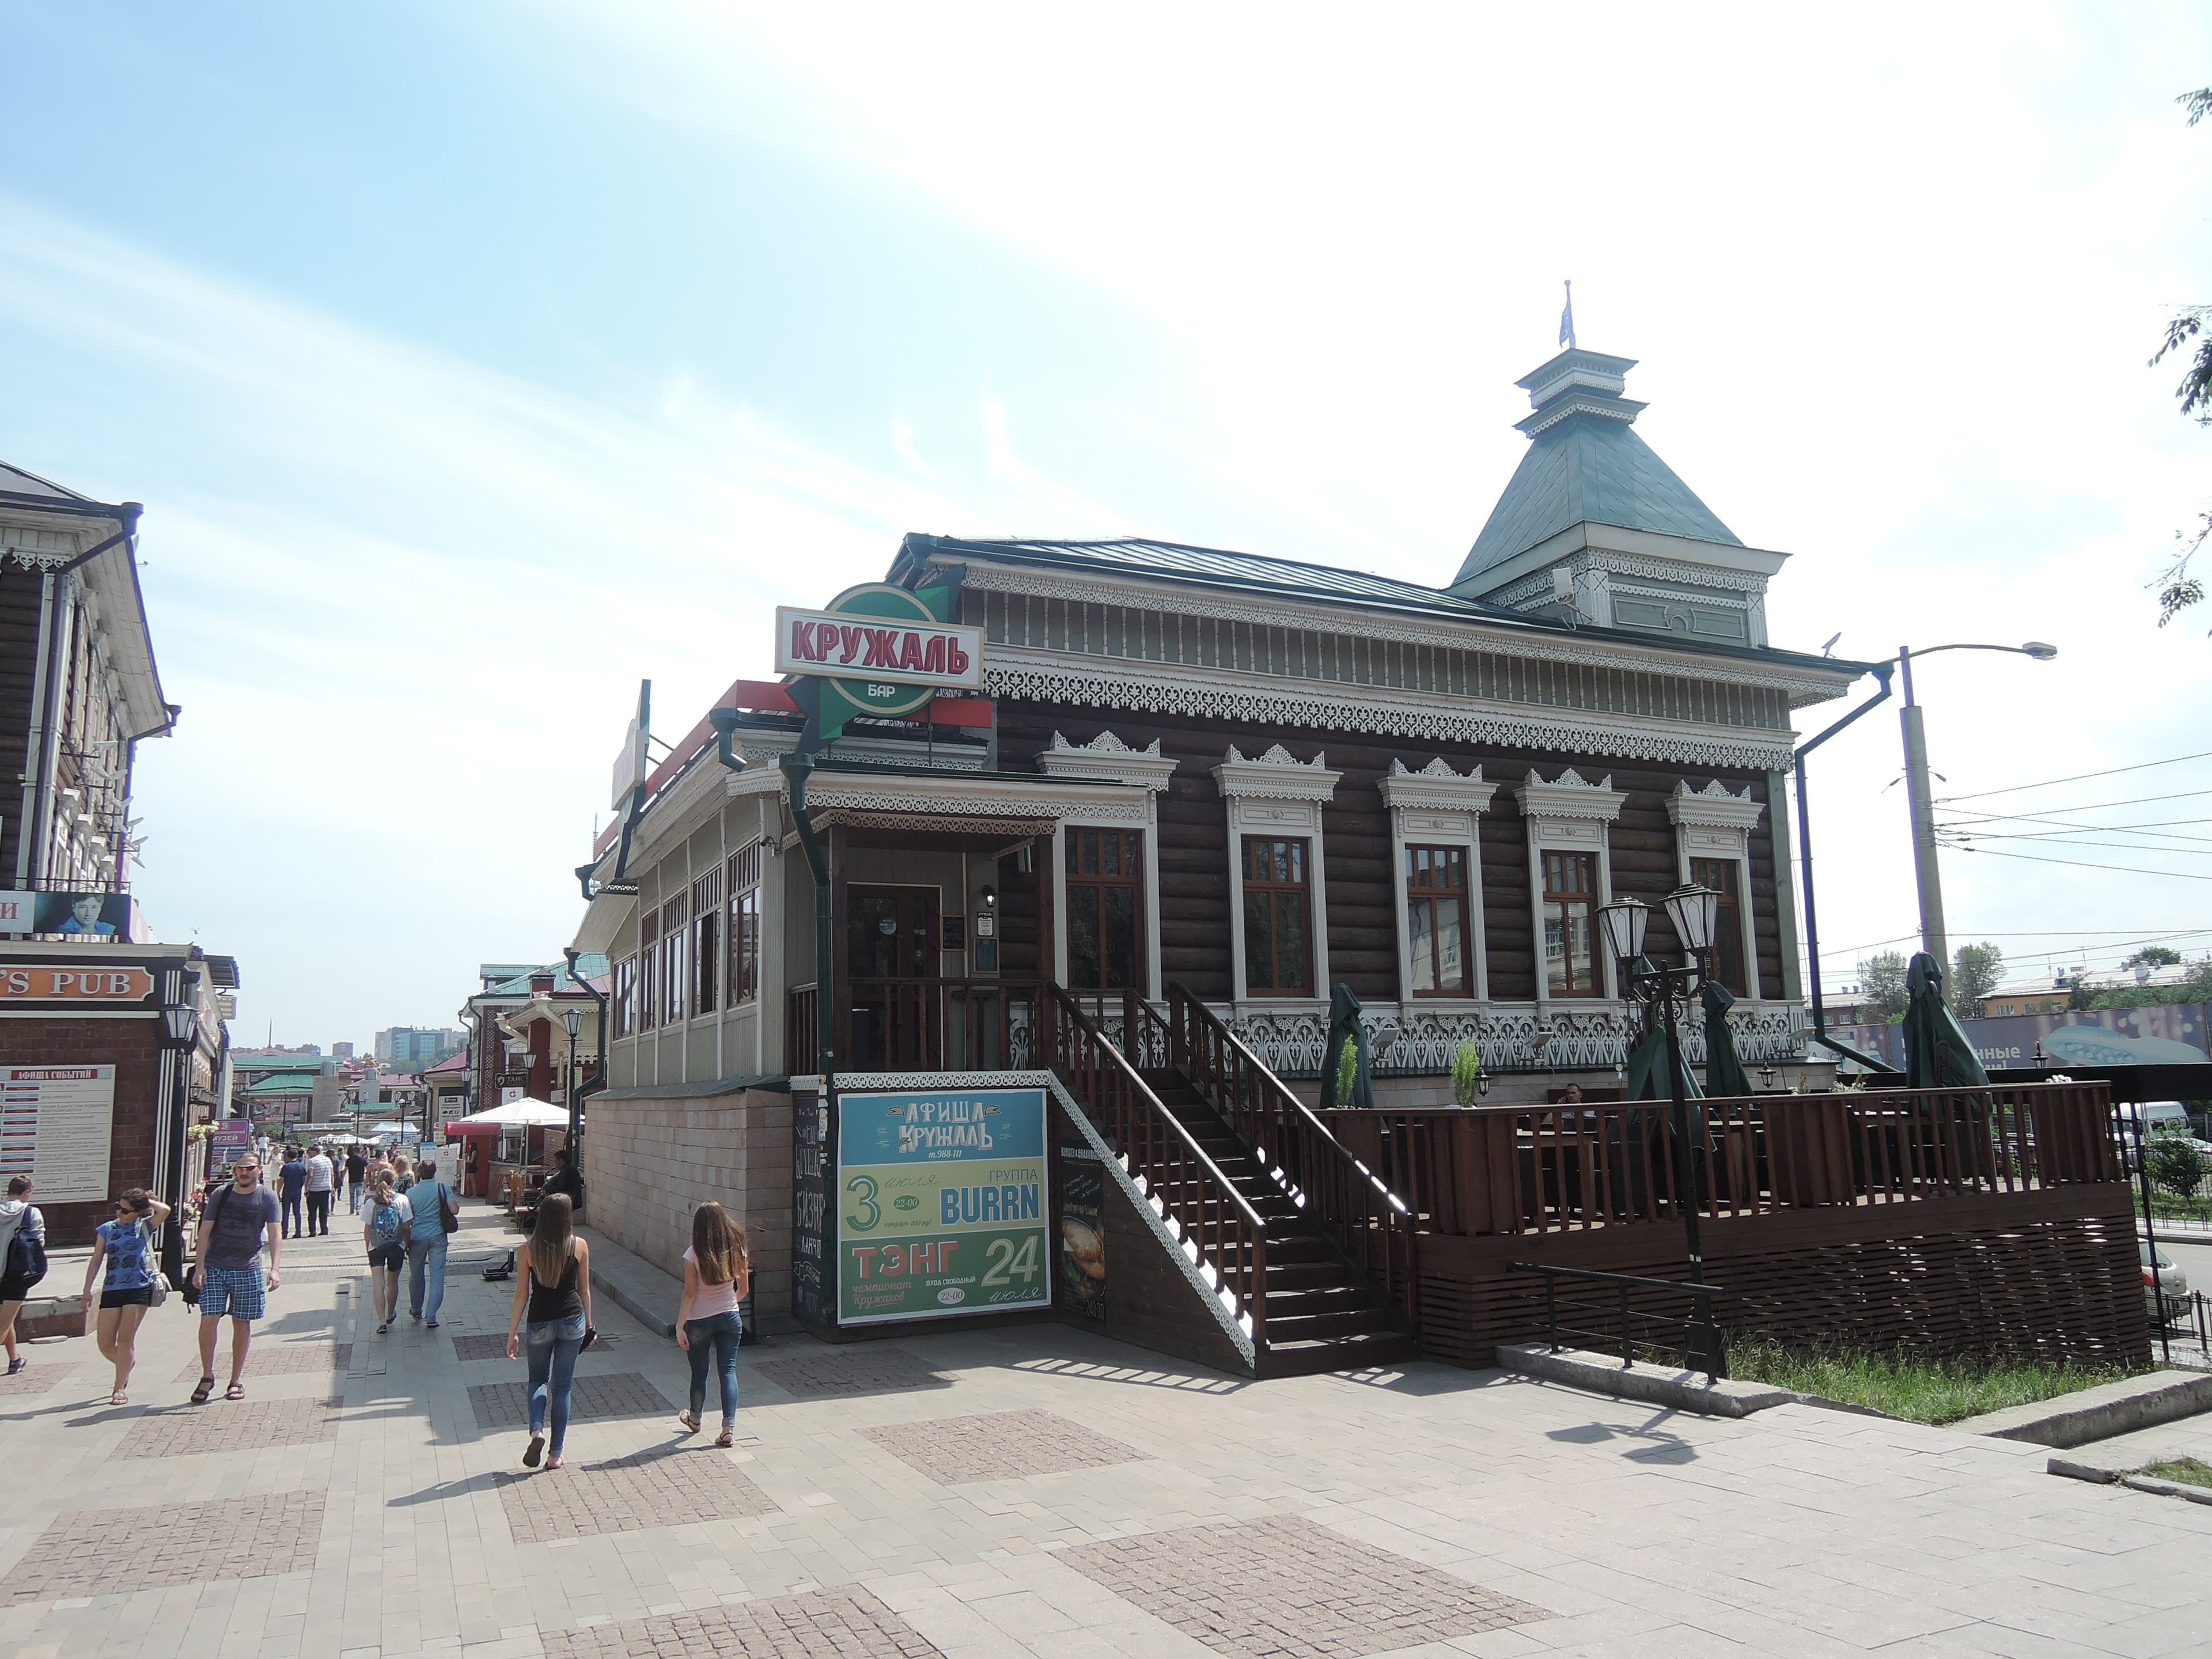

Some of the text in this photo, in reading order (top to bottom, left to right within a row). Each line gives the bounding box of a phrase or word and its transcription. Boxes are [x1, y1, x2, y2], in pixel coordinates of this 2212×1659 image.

[792, 620, 969, 675] КРУЖАЛЬ
[868, 684, 895, 698] БАР
[50, 972, 131, 994] PUB
[18, 1069, 91, 1080] АФИША СОБЫТИЙ
[906, 1101, 984, 1123] АФИША
[899, 1123, 993, 1153] КРУЖАЛЬ
[990, 1168, 1038, 1182] ГРУППА
[846, 1175, 881, 1232] 3
[895, 1198, 918, 1208] 22-00
[940, 1183, 1040, 1226] BURRN
[852, 1241, 959, 1279] ТЭНГ
[980, 1235, 1039, 1287] 24
[853, 1281, 912, 1291] чемпионат
[942, 1275, 976, 1286] СВОБОДНЫЙ
[940, 1291, 963, 1301] 22-00
